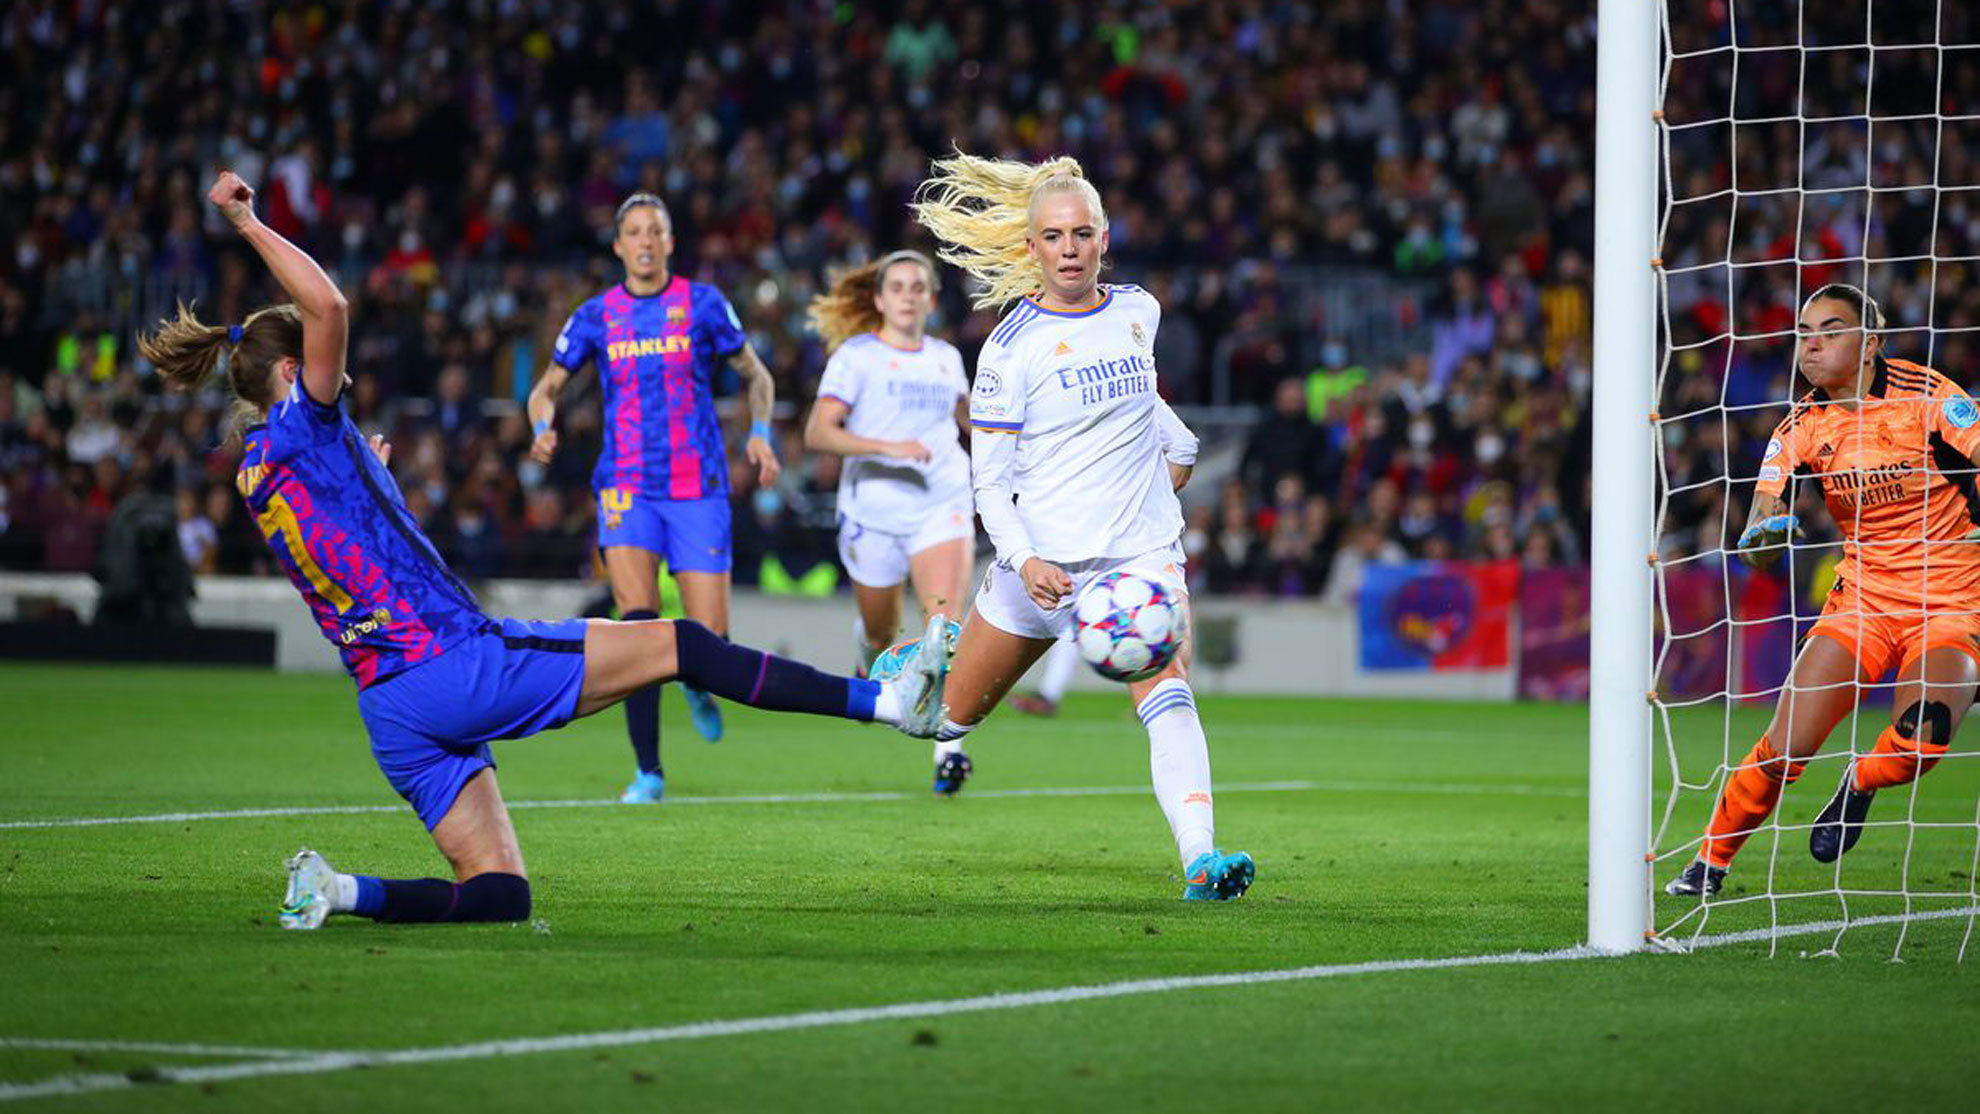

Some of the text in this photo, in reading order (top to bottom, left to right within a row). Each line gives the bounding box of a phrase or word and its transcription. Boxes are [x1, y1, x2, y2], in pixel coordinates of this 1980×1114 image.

[607, 335, 691, 361] STANLEY
[1082, 376, 1149, 405] FLY BETTER
